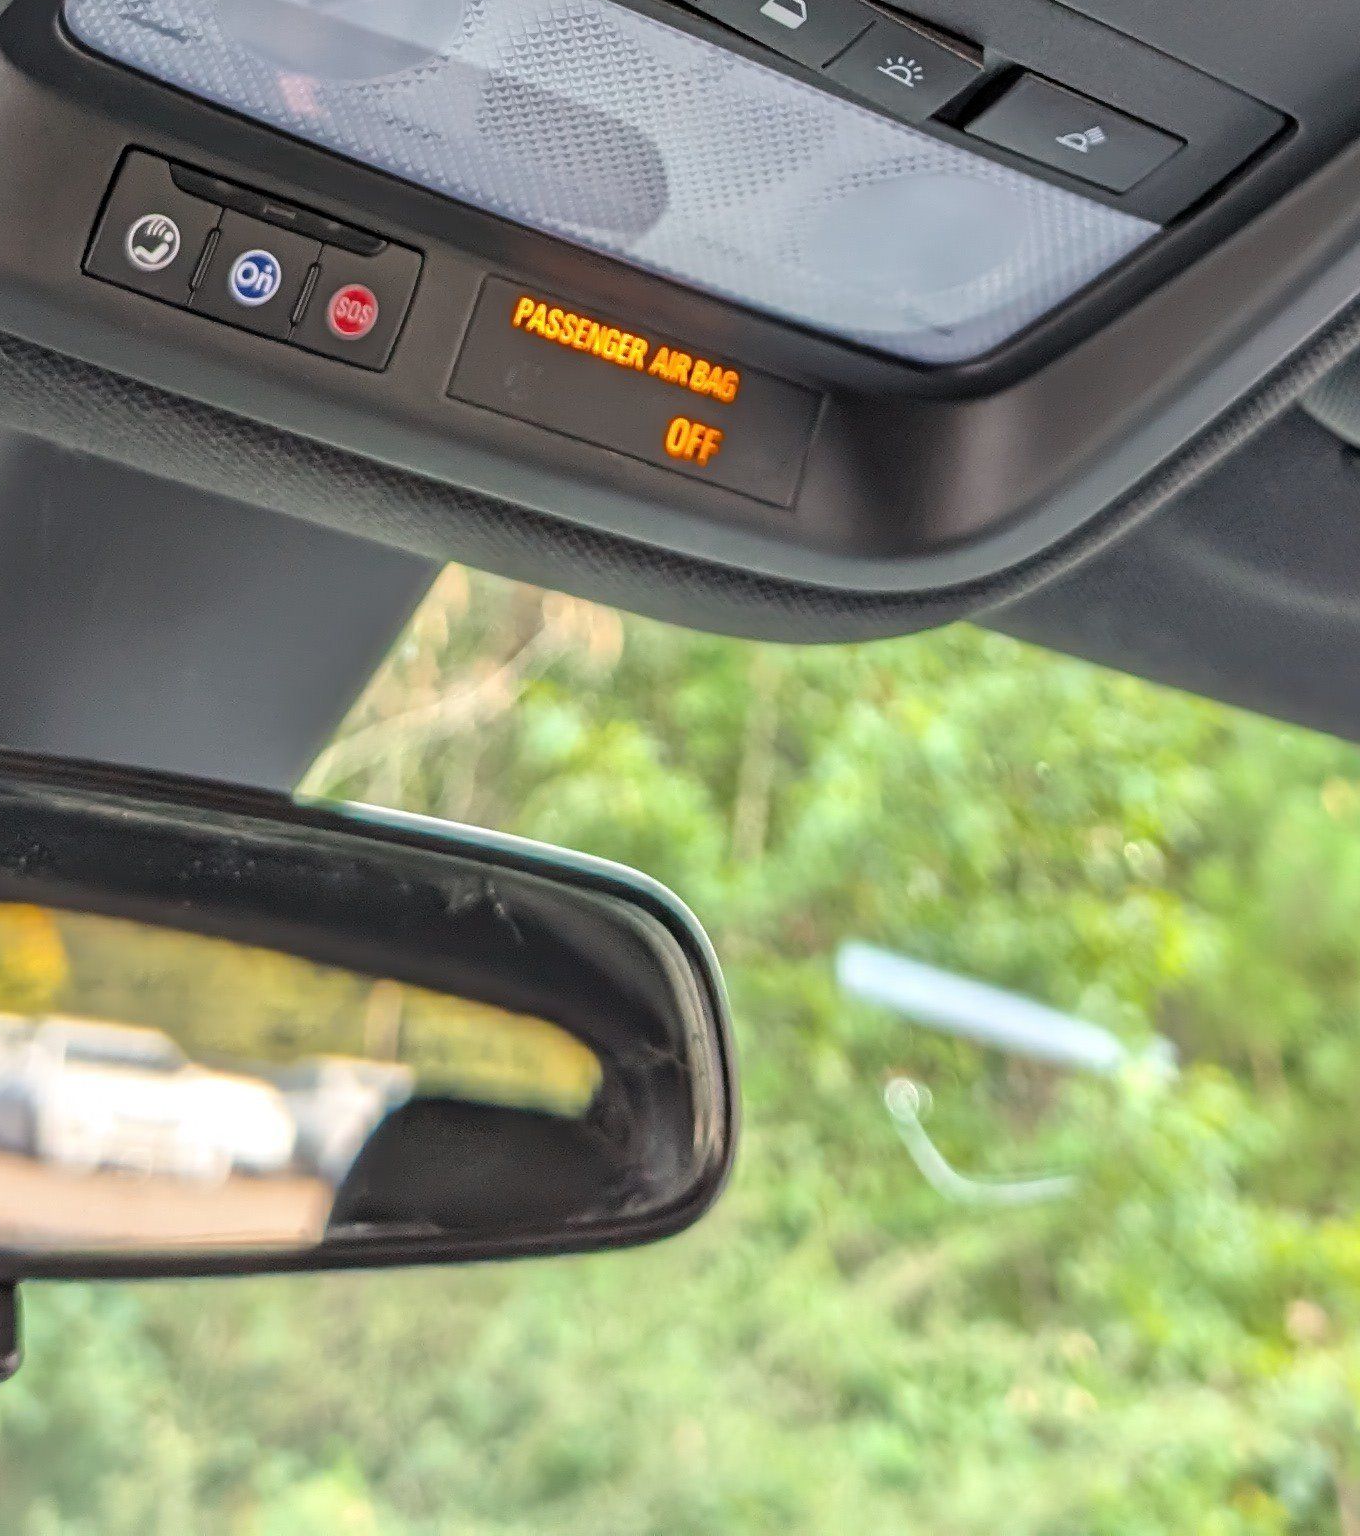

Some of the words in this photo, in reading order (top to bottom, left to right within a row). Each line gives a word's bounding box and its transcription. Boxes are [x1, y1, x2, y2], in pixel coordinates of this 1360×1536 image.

[334, 296, 374, 324] SOS
[512, 296, 649, 371] PASSENGER
[665, 417, 725, 468] OFF
